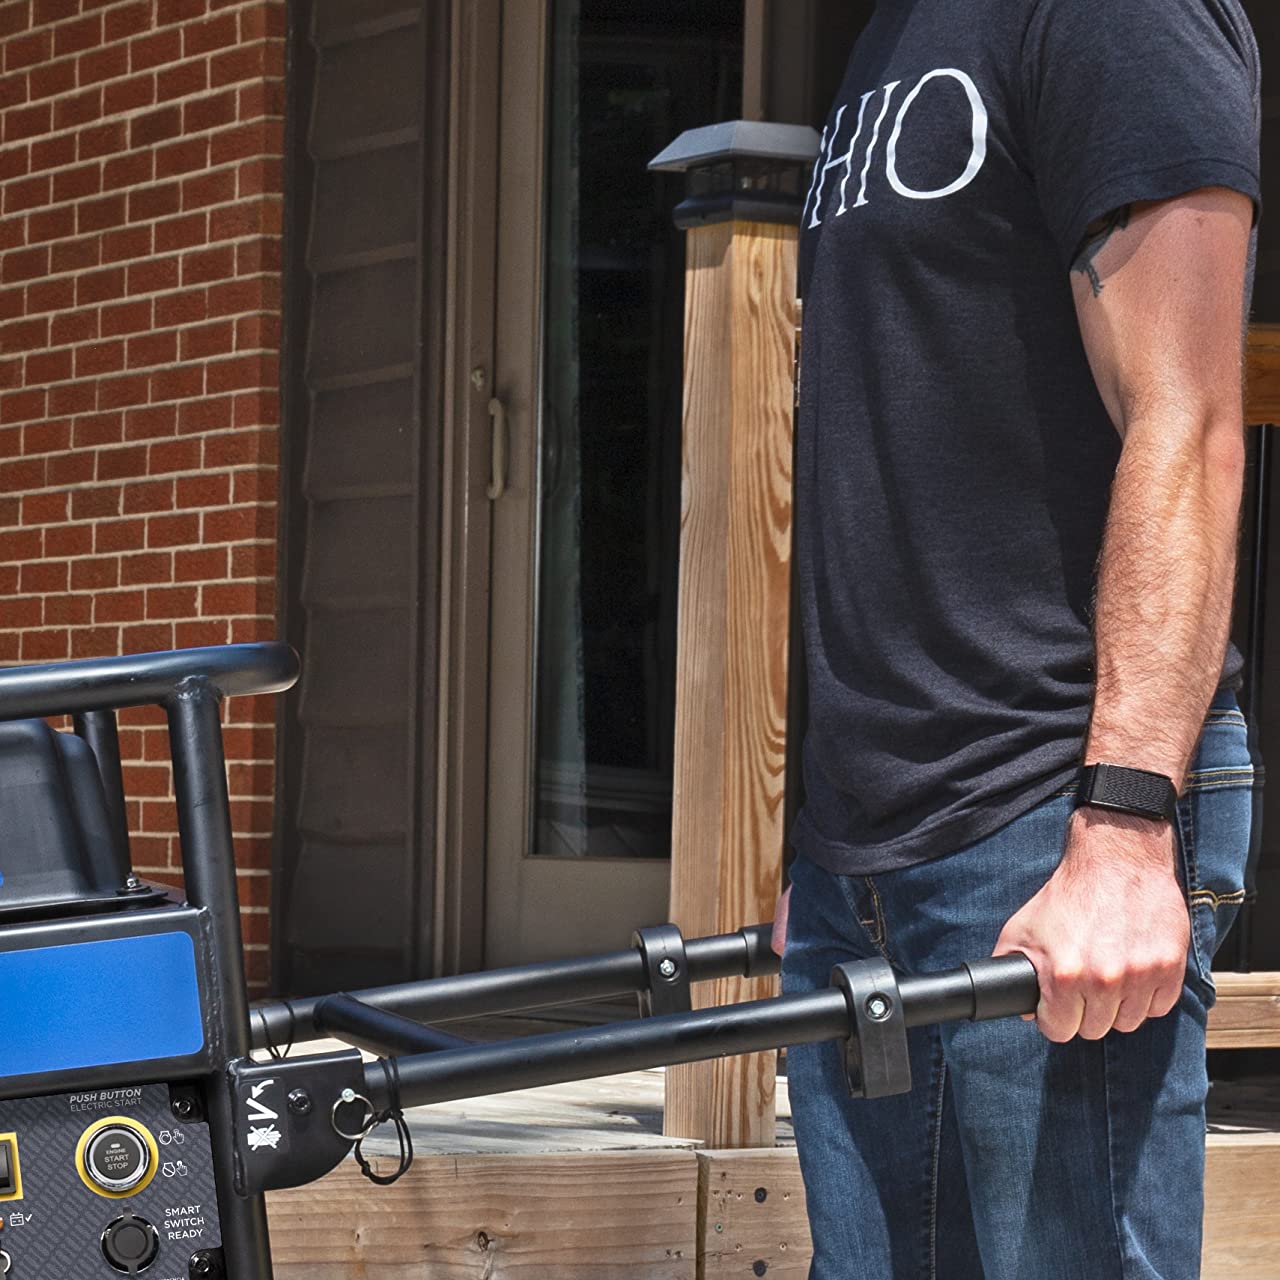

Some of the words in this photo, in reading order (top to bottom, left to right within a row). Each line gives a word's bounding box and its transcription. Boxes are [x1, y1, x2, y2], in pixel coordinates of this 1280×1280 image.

[69, 1093, 97, 1104] PUSH
[99, 1088, 142, 1100] BUTTON
[70, 1101, 113, 1112] ELECTRIC
[114, 1098, 142, 1107] START
[104, 1154, 129, 1163] START
[107, 1162, 129, 1170] STOP
[165, 1204, 200, 1217] SMART
[164, 1216, 205, 1229] SWITCH
[168, 1228, 204, 1240] READY
